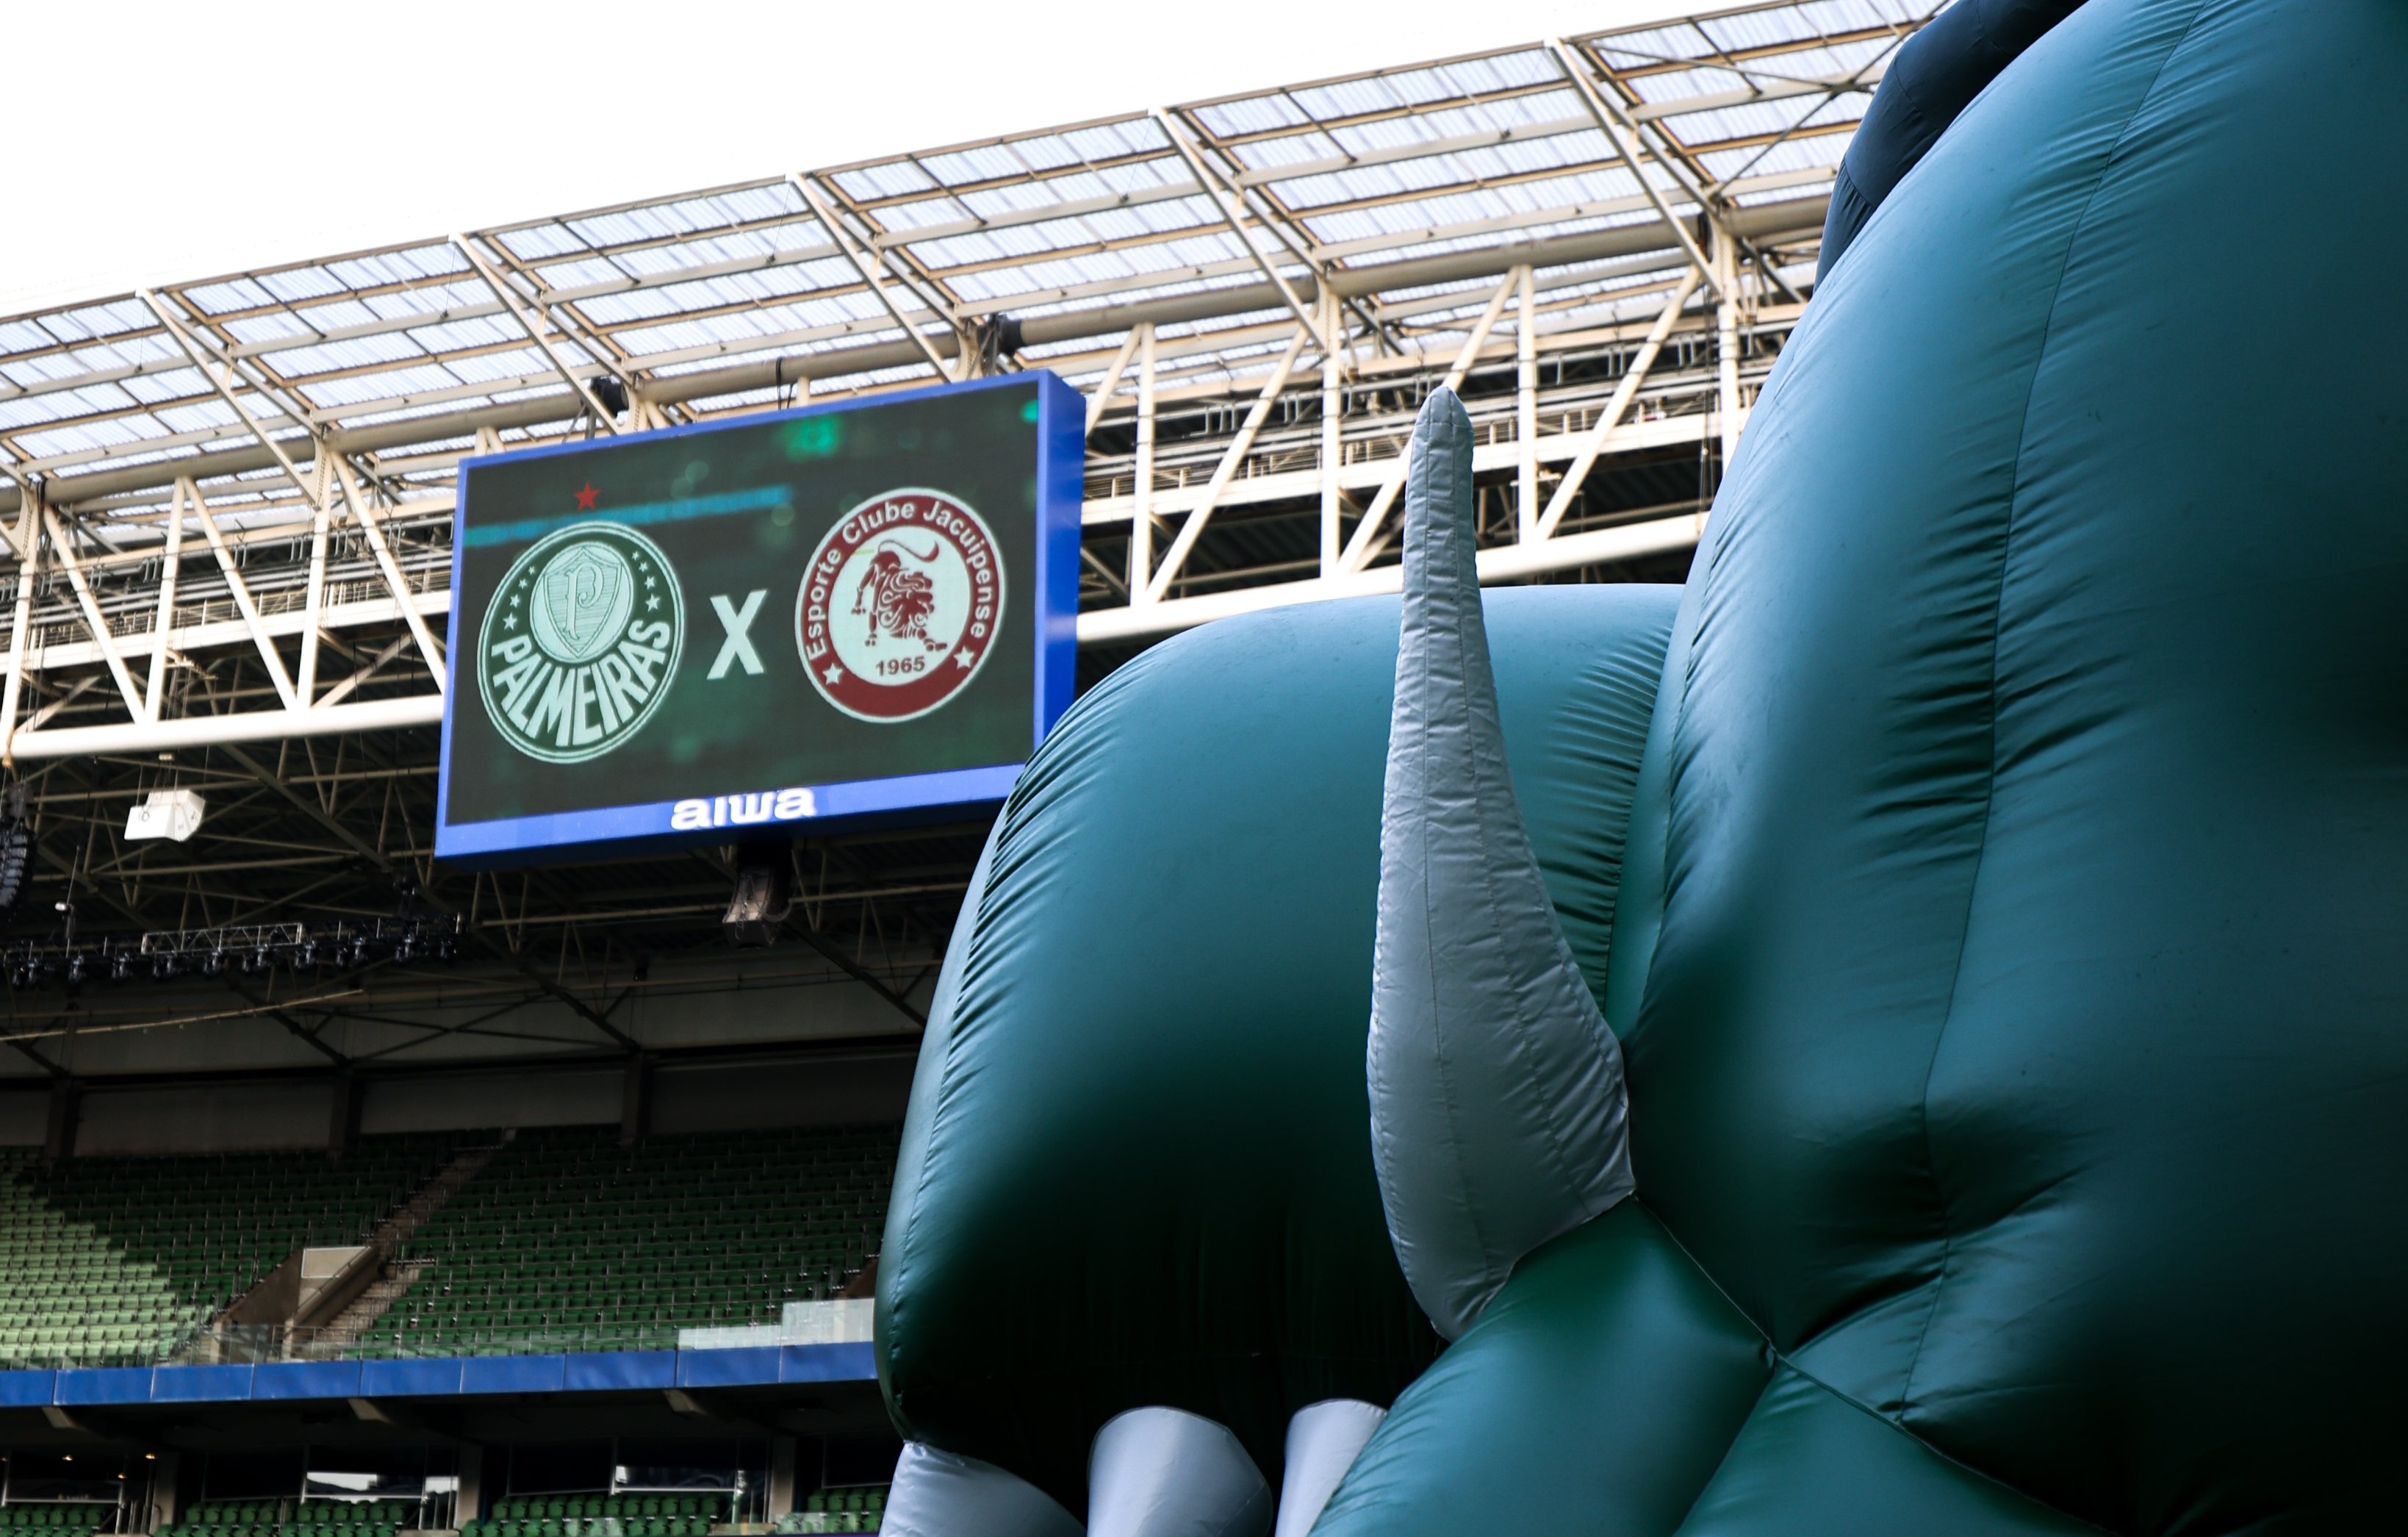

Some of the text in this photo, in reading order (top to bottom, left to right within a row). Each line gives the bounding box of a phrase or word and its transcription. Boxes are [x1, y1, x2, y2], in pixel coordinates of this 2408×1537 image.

[806, 501, 993, 661] Esporte Clube Jacuipense
[706, 589, 767, 680] X
[875, 656, 926, 677] 1965
[491, 620, 671, 747] PALMEIRAS
[670, 787, 817, 831] aiwa
